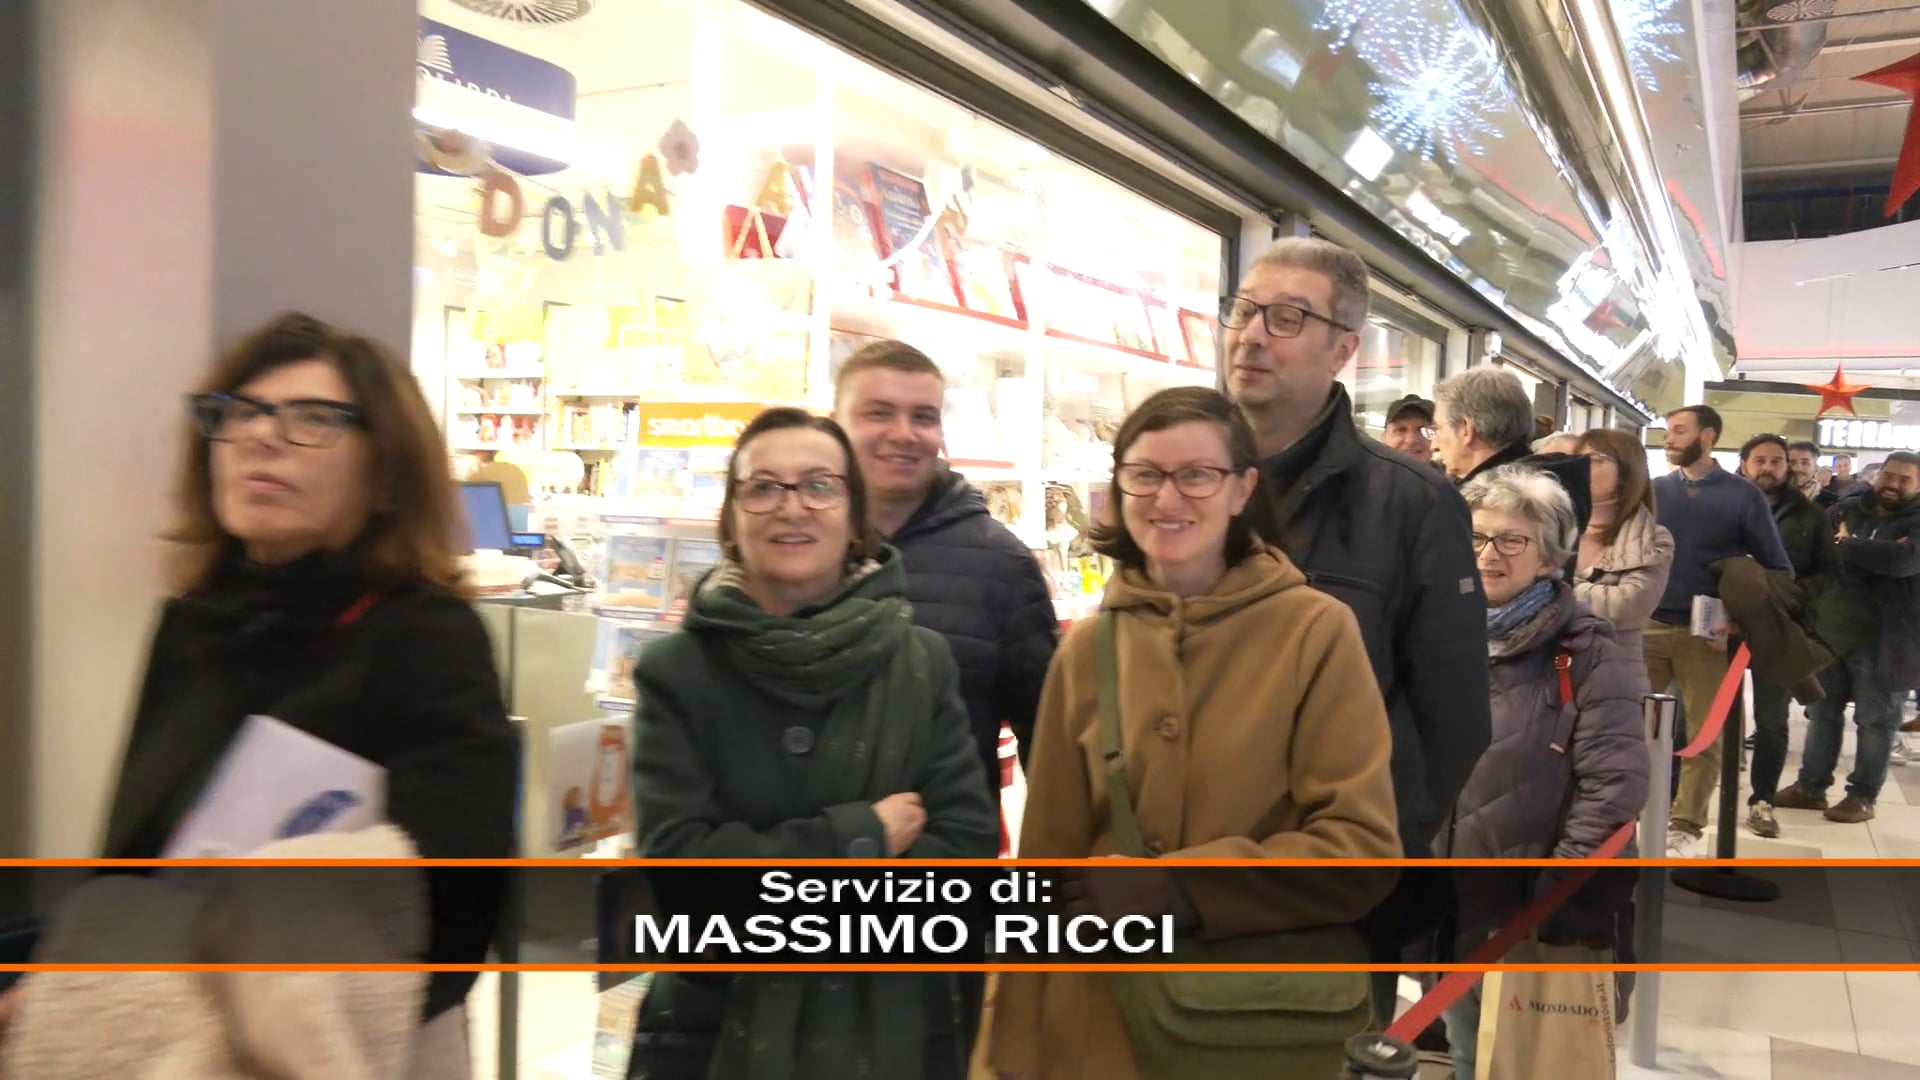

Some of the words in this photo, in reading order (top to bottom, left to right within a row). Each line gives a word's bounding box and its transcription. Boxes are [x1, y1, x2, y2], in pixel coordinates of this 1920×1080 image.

[646, 413, 745, 437] smartbo
[1818, 418, 1920, 450] TERRA
[1528, 1000, 1600, 1017] MONDADO
